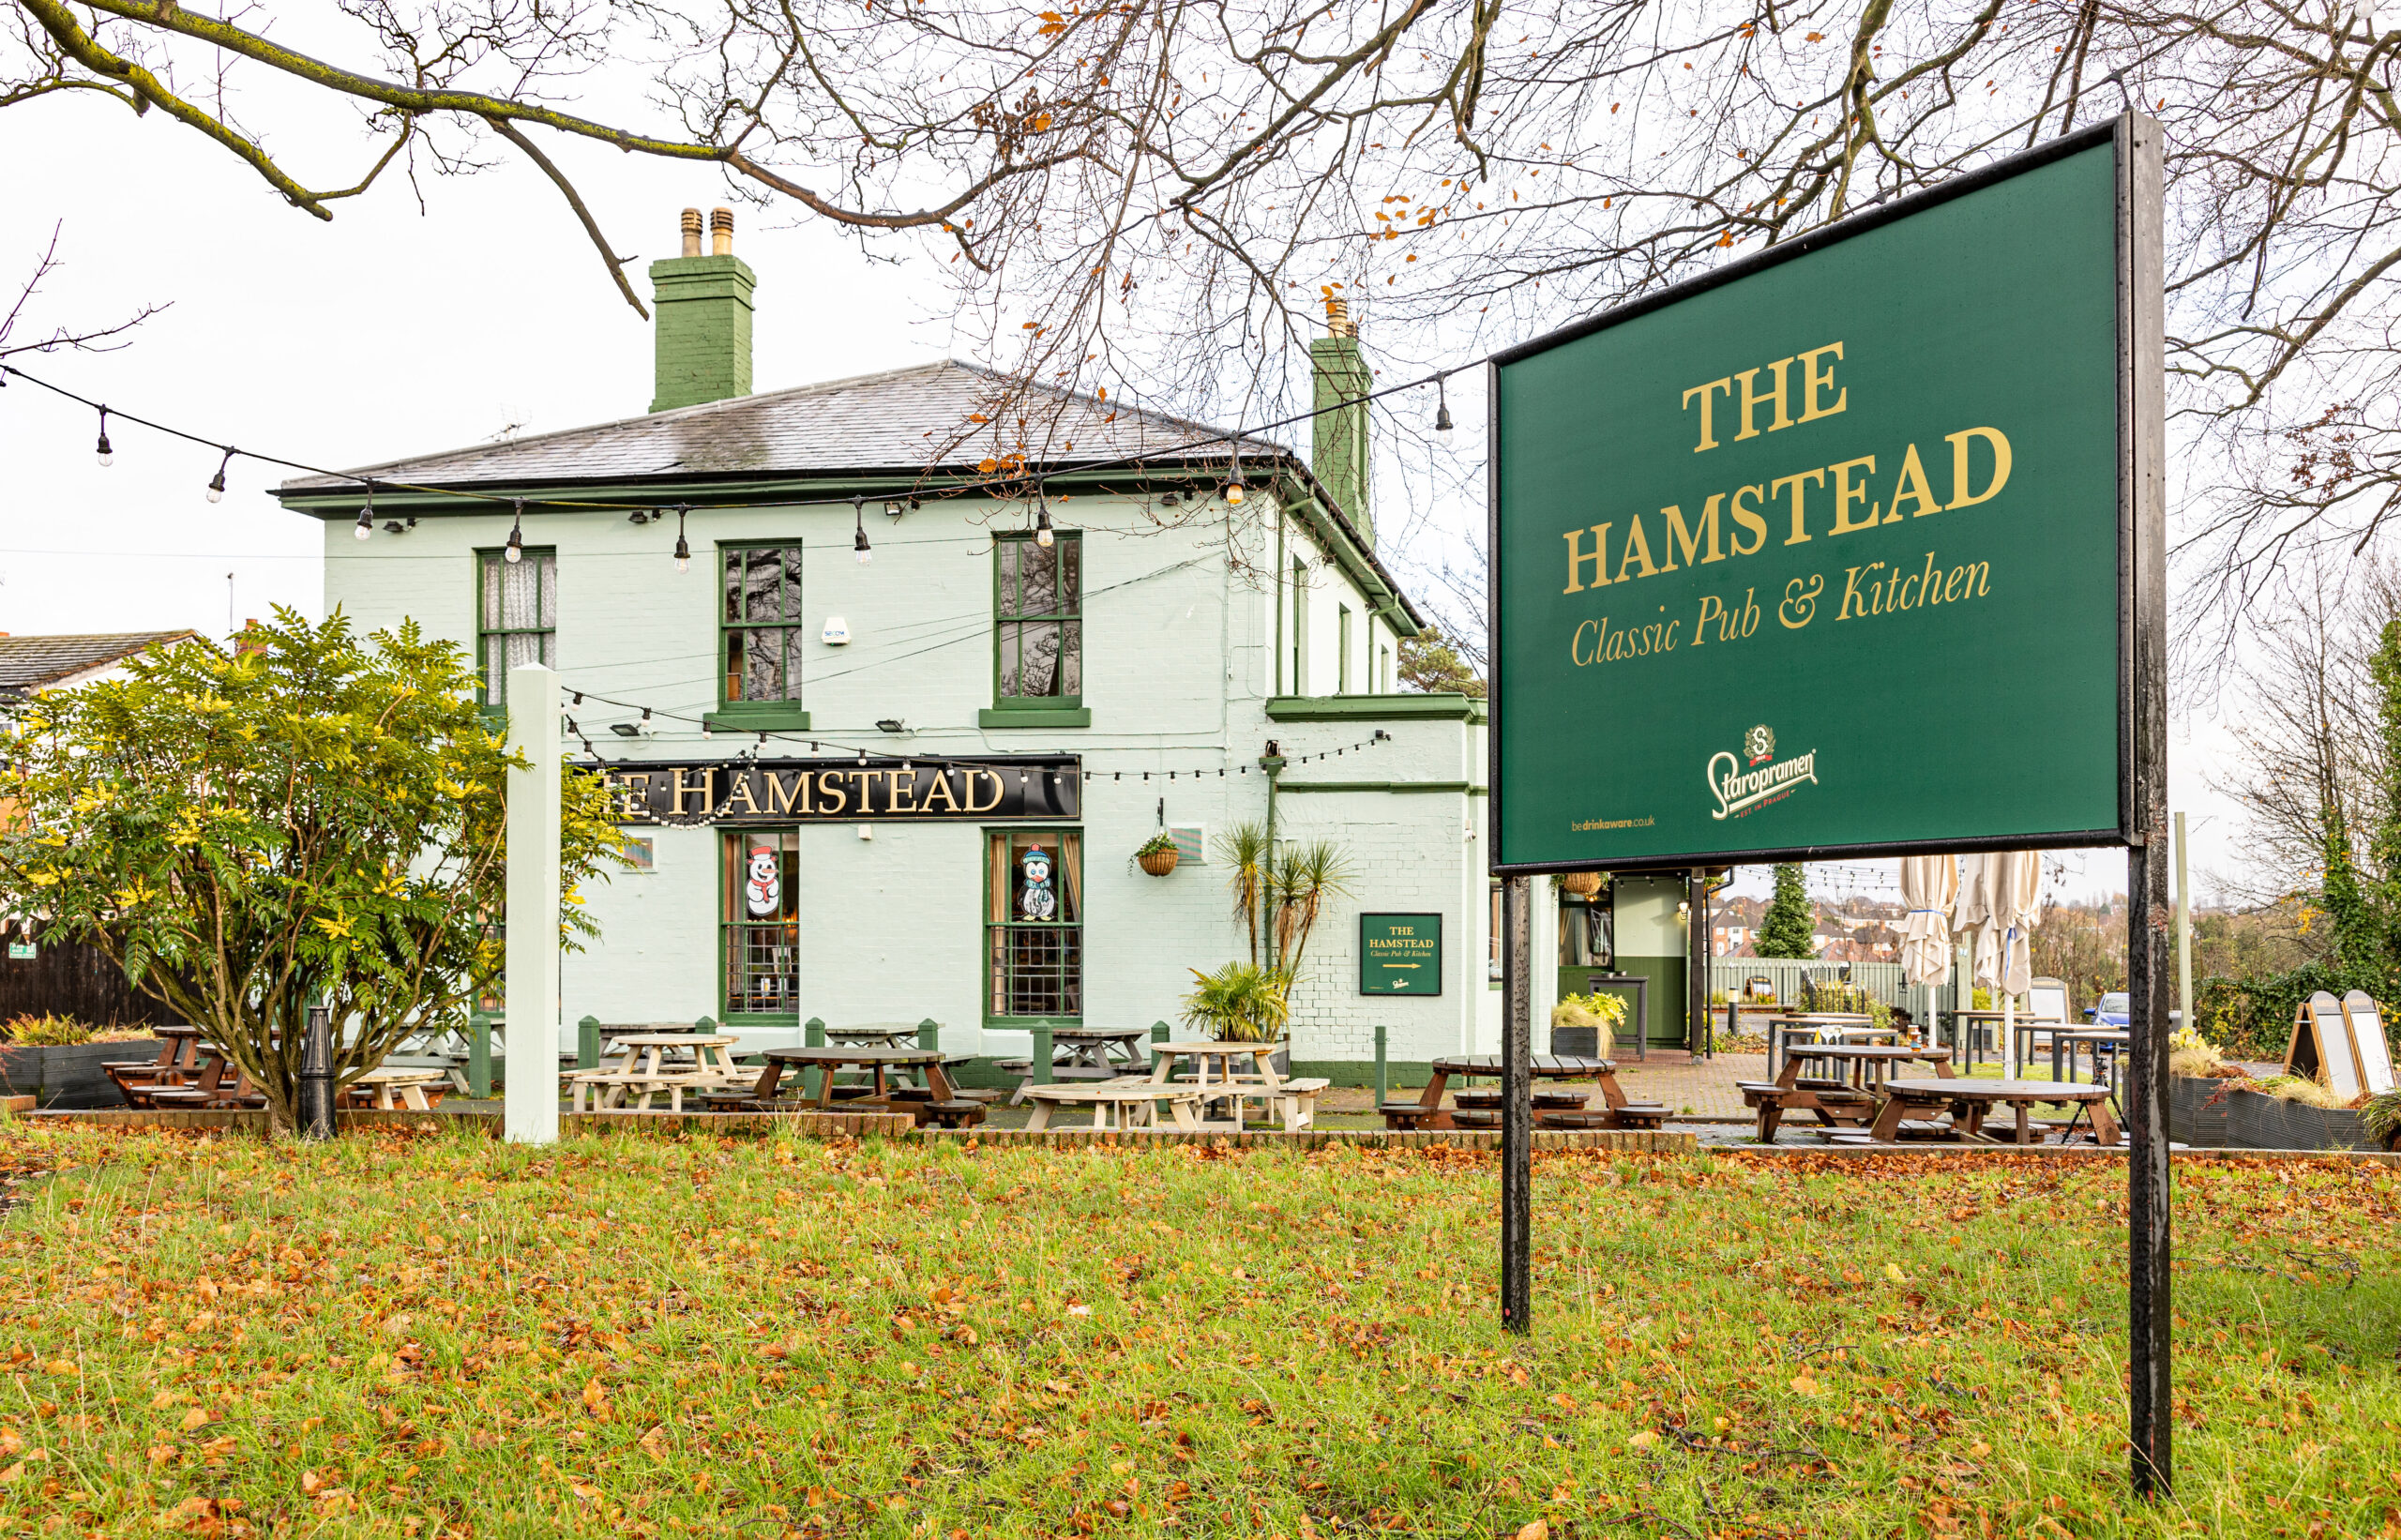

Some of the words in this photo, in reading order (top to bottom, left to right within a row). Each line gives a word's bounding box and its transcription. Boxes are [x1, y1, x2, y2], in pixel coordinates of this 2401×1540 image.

[1682, 340, 1848, 453] THE
[1563, 425, 2013, 595] HAMSTEAD
[1571, 608, 1680, 667] Classic
[1691, 588, 1760, 646] Pub
[1778, 573, 1824, 629] &
[1835, 551, 1990, 621] Kitchen
[667, 766, 1005, 815] HAMSTEAD
[1707, 750, 1819, 820] Staropramen
[1763, 790, 1789, 808] PRAGUE
[1368, 939, 1434, 948] HAMSTEAD
[1389, 926, 1414, 935] THE
